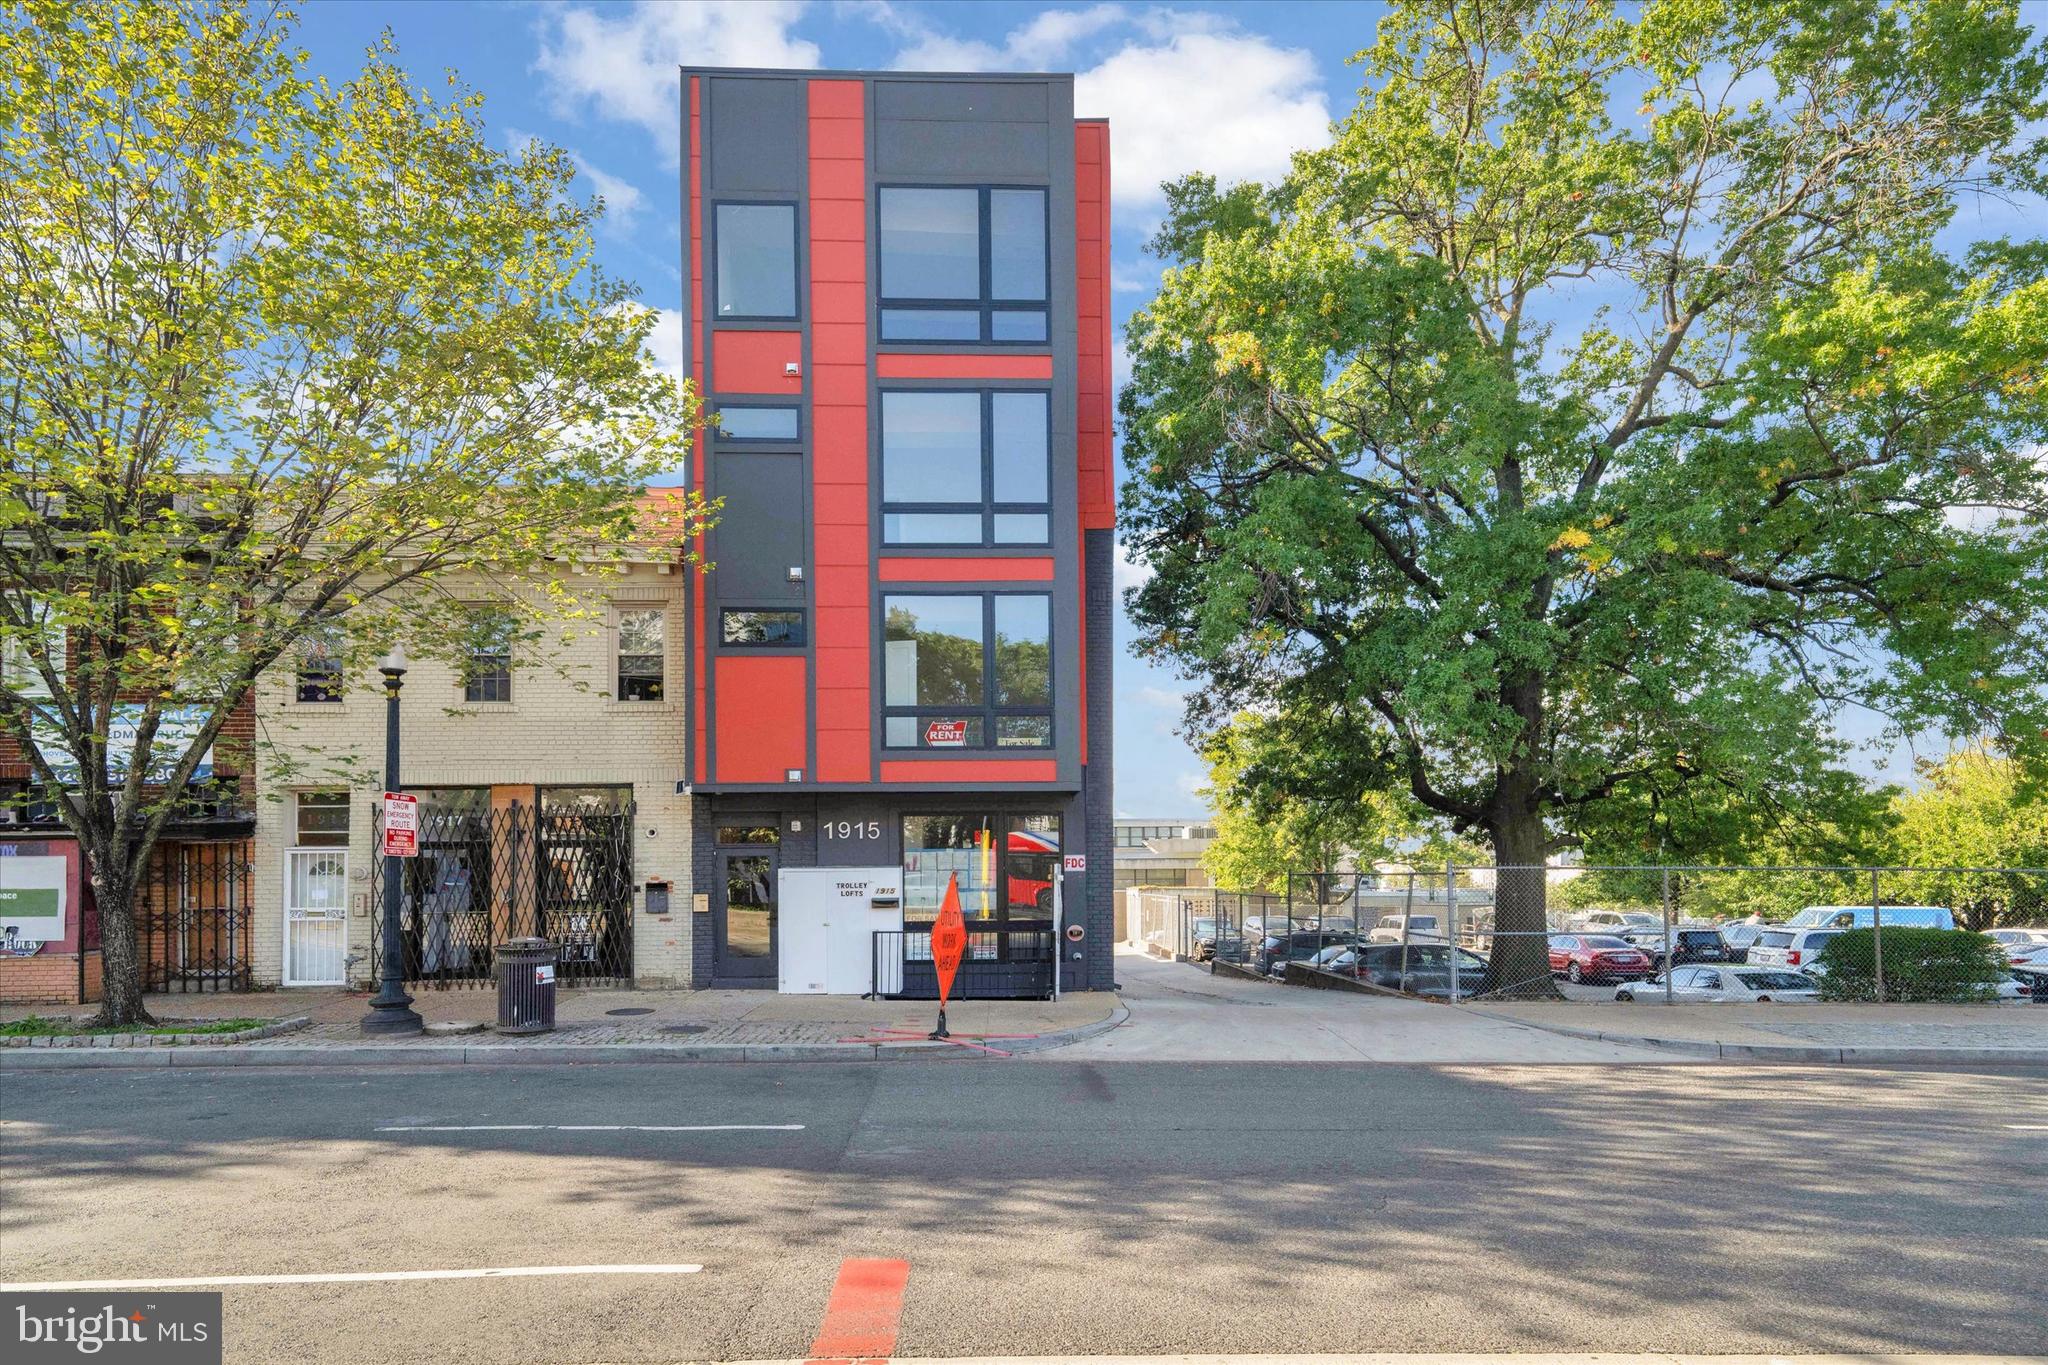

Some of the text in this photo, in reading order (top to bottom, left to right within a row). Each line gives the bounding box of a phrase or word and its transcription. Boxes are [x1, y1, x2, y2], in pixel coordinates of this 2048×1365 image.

[929, 730, 962, 740] RENT
[392, 802, 410, 811] SNOW
[387, 811, 414, 820] EMERGENCY
[391, 820, 411, 829] ROUTE
[823, 821, 880, 840] 1915
[1065, 858, 1085, 868] FDC
[875, 887, 896, 895] 1915
[940, 910, 961, 927] UTILITY
[942, 933, 957, 948] WORK
[938, 954, 956, 971] AHEAD
